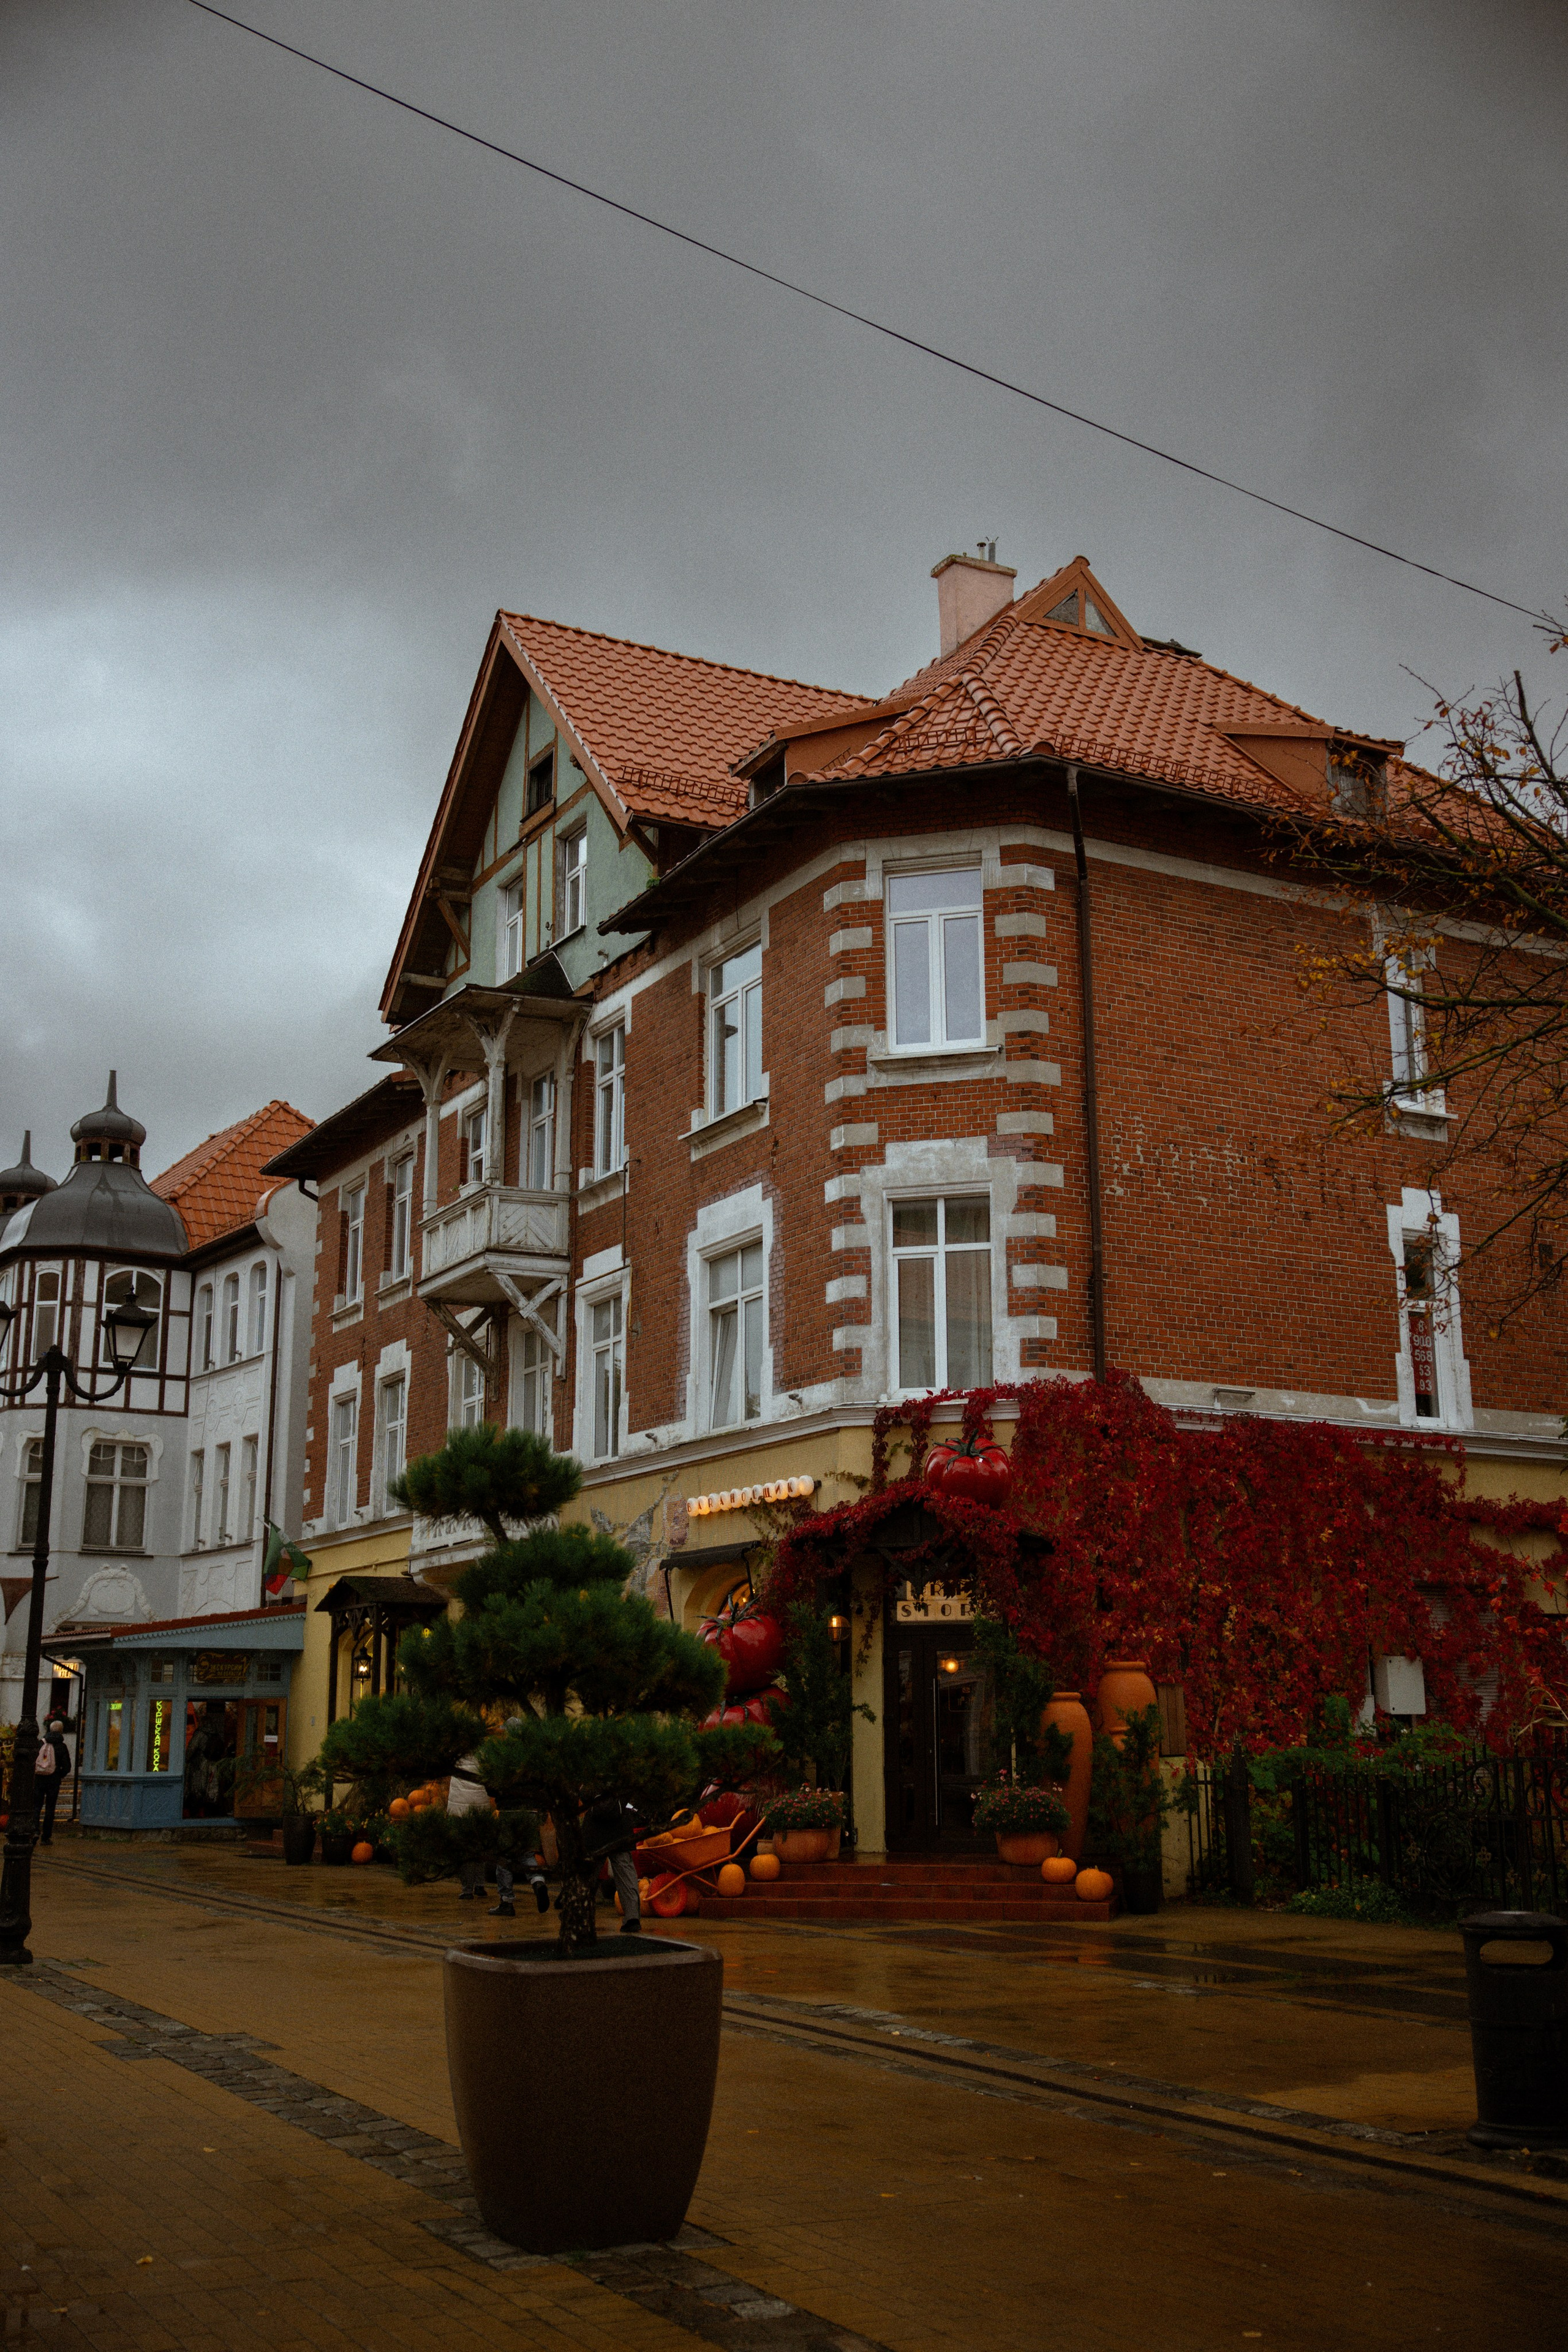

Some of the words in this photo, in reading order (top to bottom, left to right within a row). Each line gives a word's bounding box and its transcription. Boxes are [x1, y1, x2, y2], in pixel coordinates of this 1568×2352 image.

[1418, 1320, 1424, 1332] 8
[1414, 1349, 1433, 1362] 568
[1419, 1365, 1431, 1376] 53
[1420, 1379, 1432, 1391] 93
